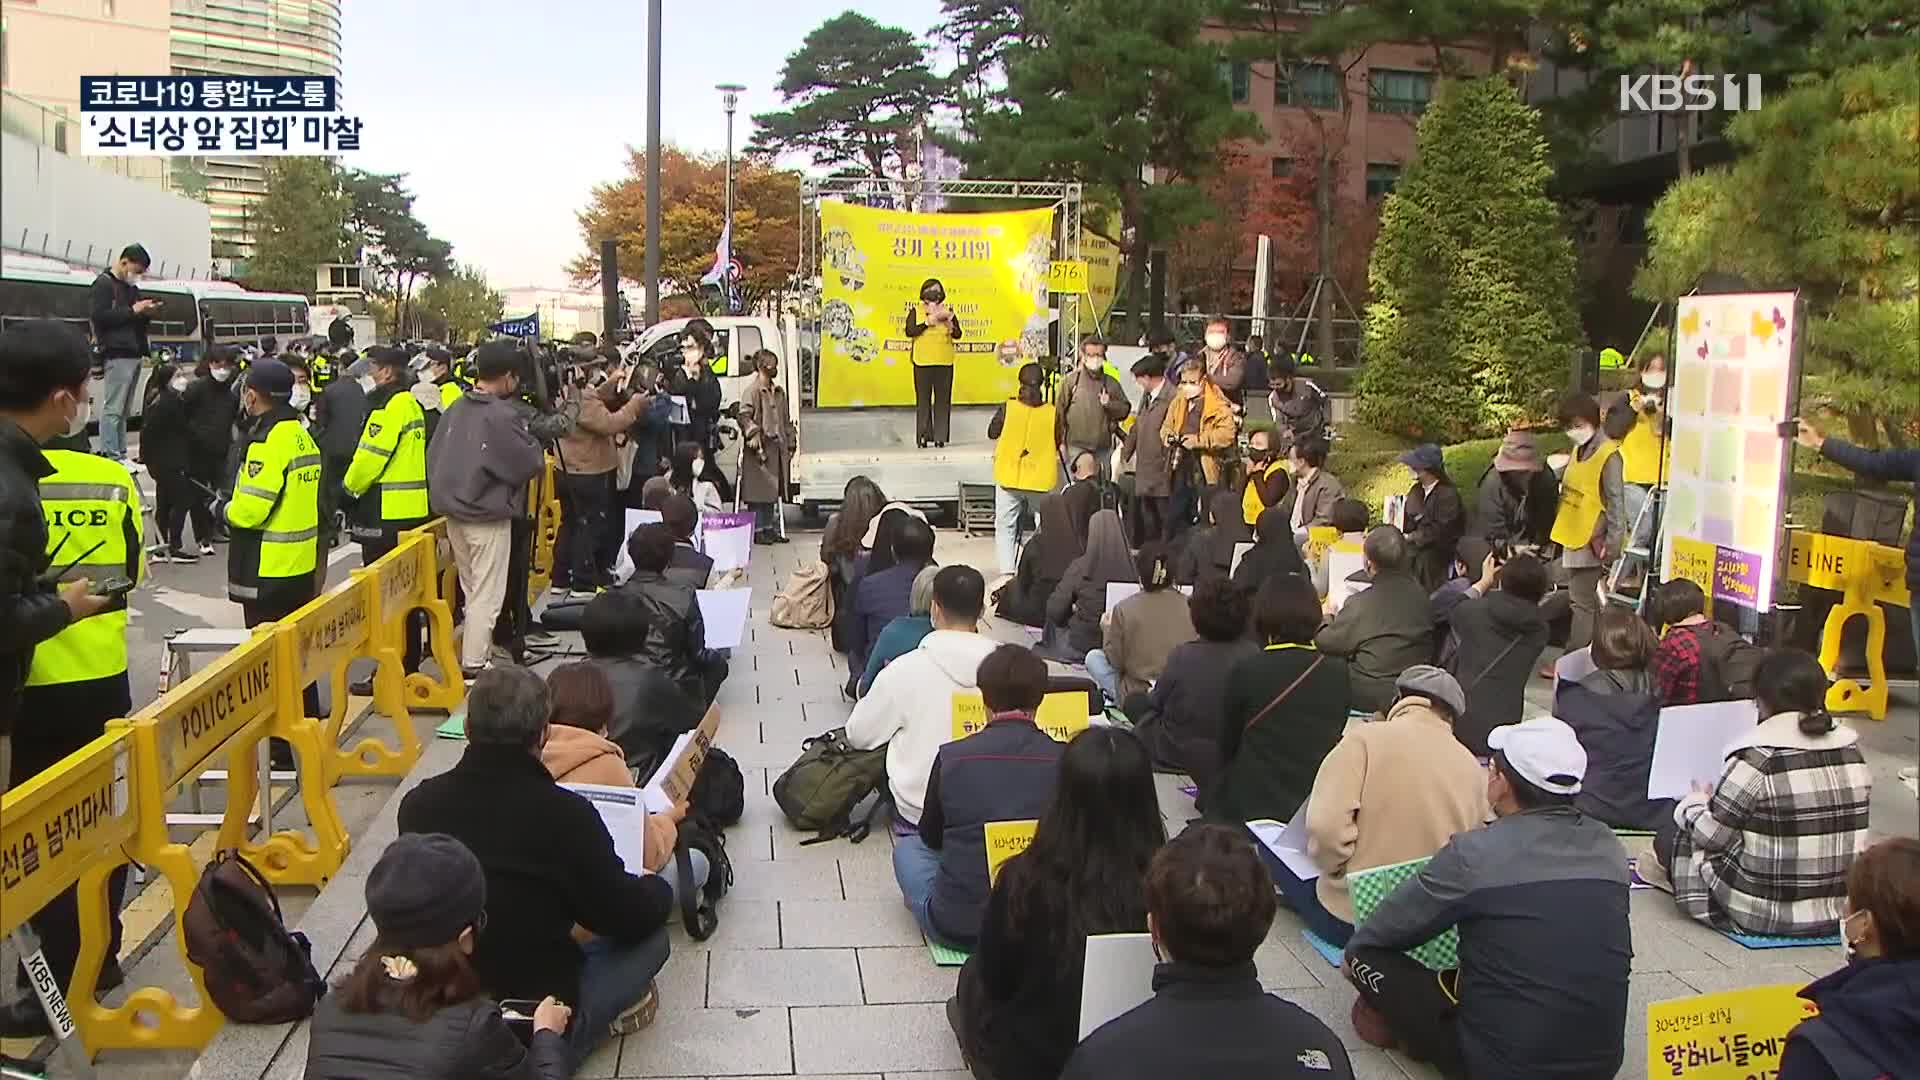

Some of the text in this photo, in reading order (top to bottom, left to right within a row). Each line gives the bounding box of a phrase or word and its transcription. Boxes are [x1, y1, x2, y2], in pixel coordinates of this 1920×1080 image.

[49, 509, 108, 526] ICE
[1807, 550, 1844, 574] LINE
[181, 660, 270, 749] POLICE LINE
[45, 783, 113, 859] 넘지마시
[28, 955, 74, 1033] KBS NEWS
[1655, 1007, 1732, 1033] 30년간의 외침
[1662, 1033, 1786, 1076] 할머니들에
